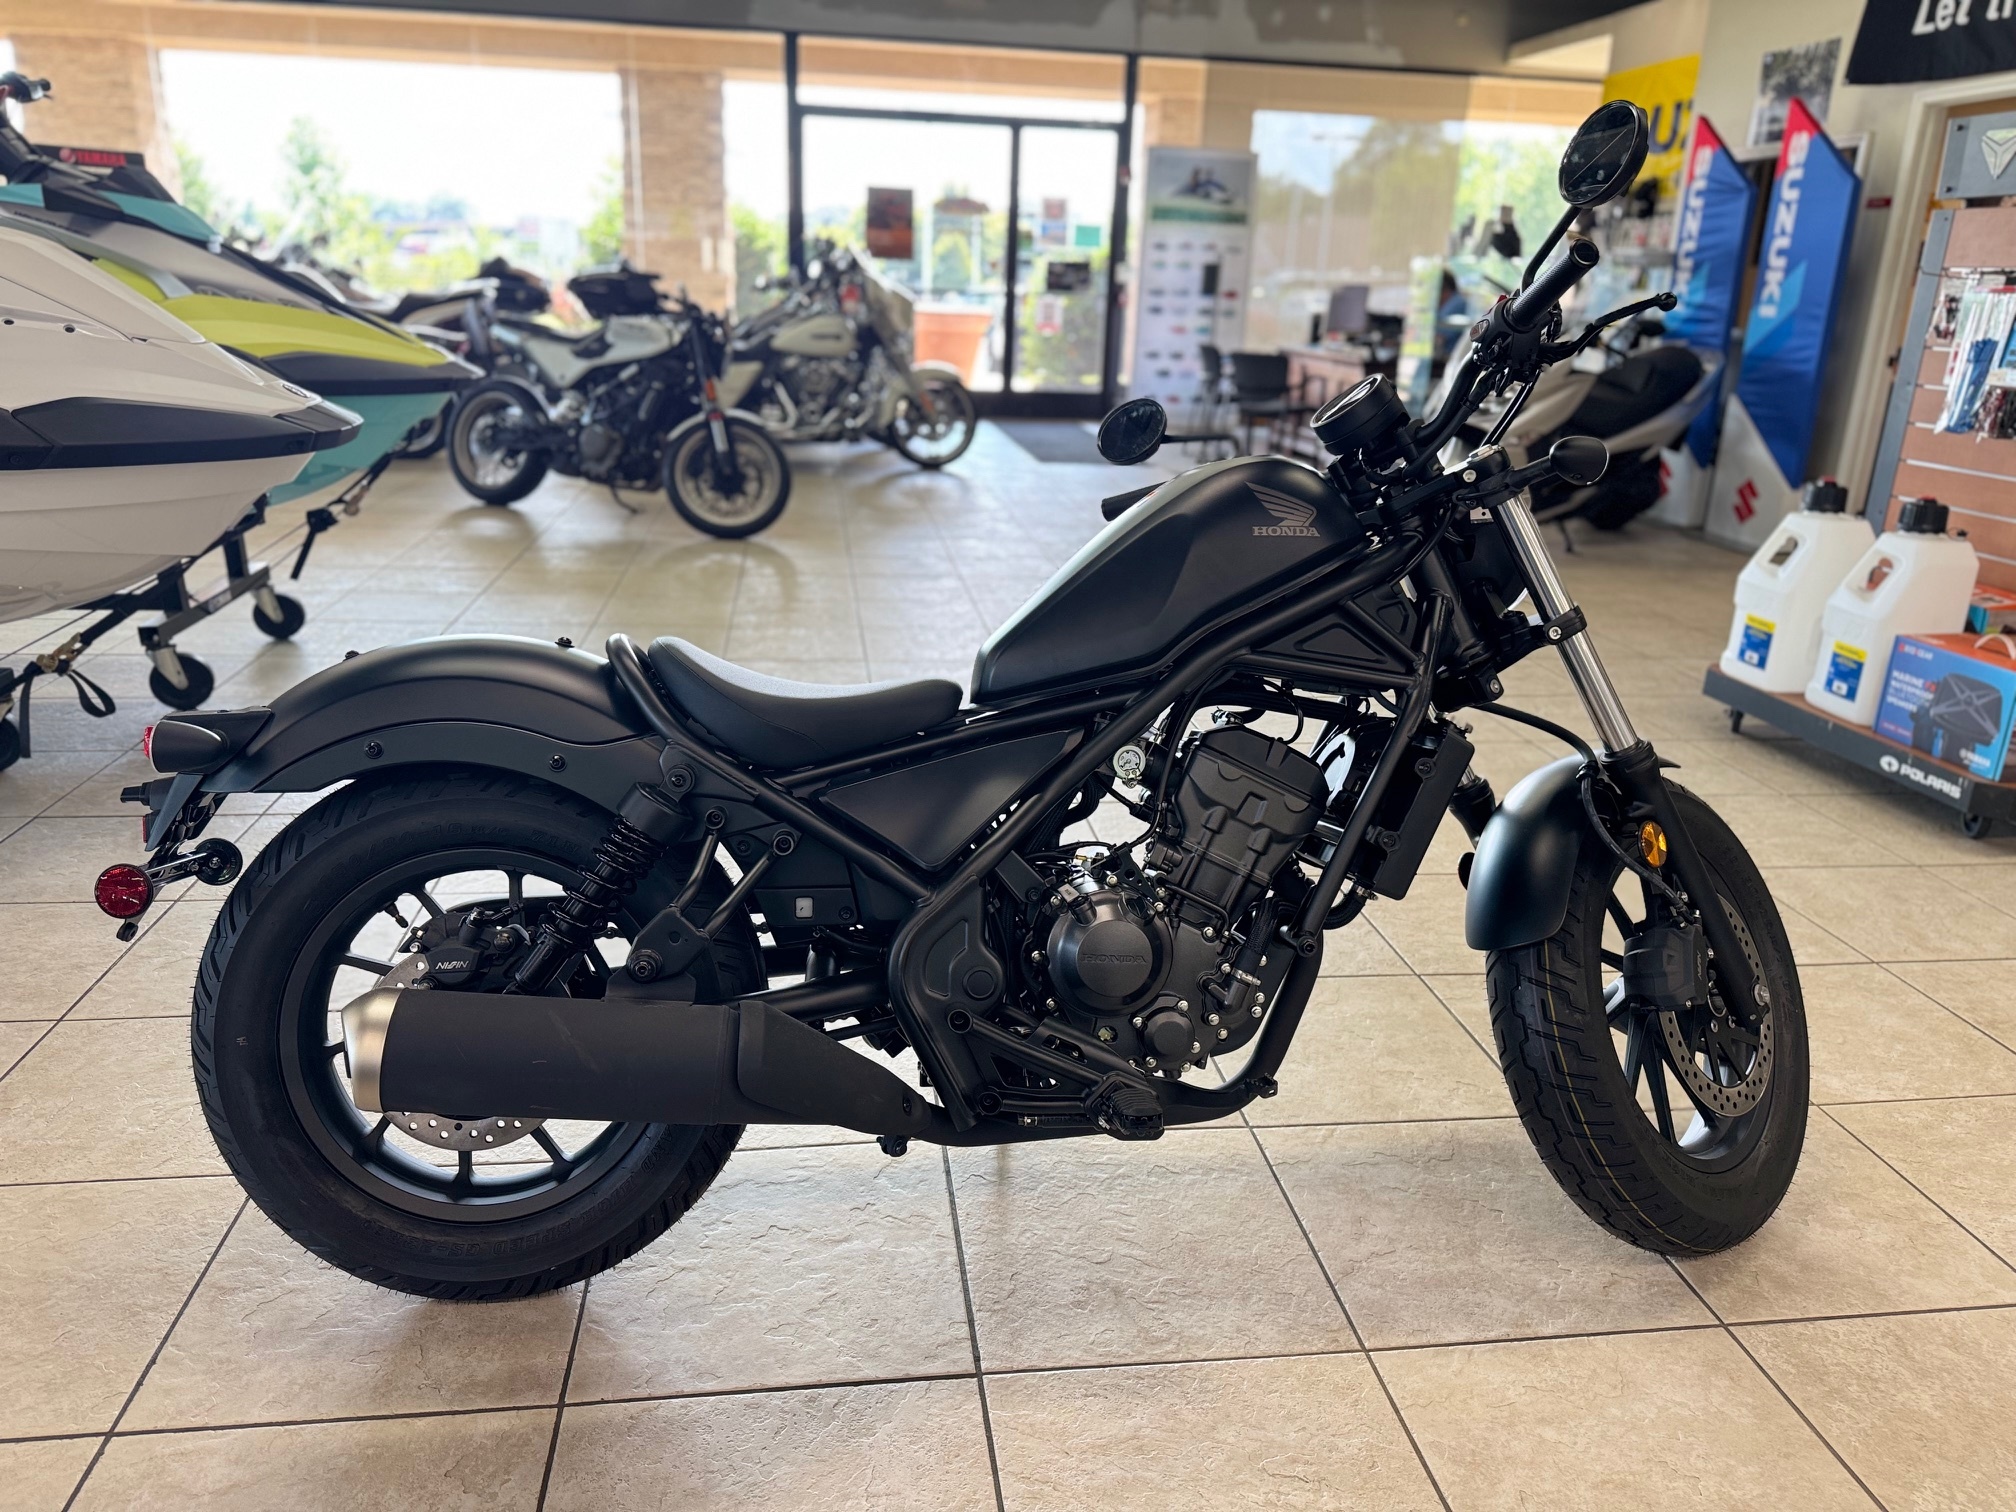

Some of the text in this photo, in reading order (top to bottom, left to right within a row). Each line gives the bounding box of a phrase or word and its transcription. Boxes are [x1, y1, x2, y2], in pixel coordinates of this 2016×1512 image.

[1758, 130, 1811, 318] SUZUKI
[1252, 526, 1321, 537] HONDA
[1900, 763, 1963, 799] POLARIS
[1081, 954, 1147, 964] HONDA
[435, 960, 469, 970] NISSIN
